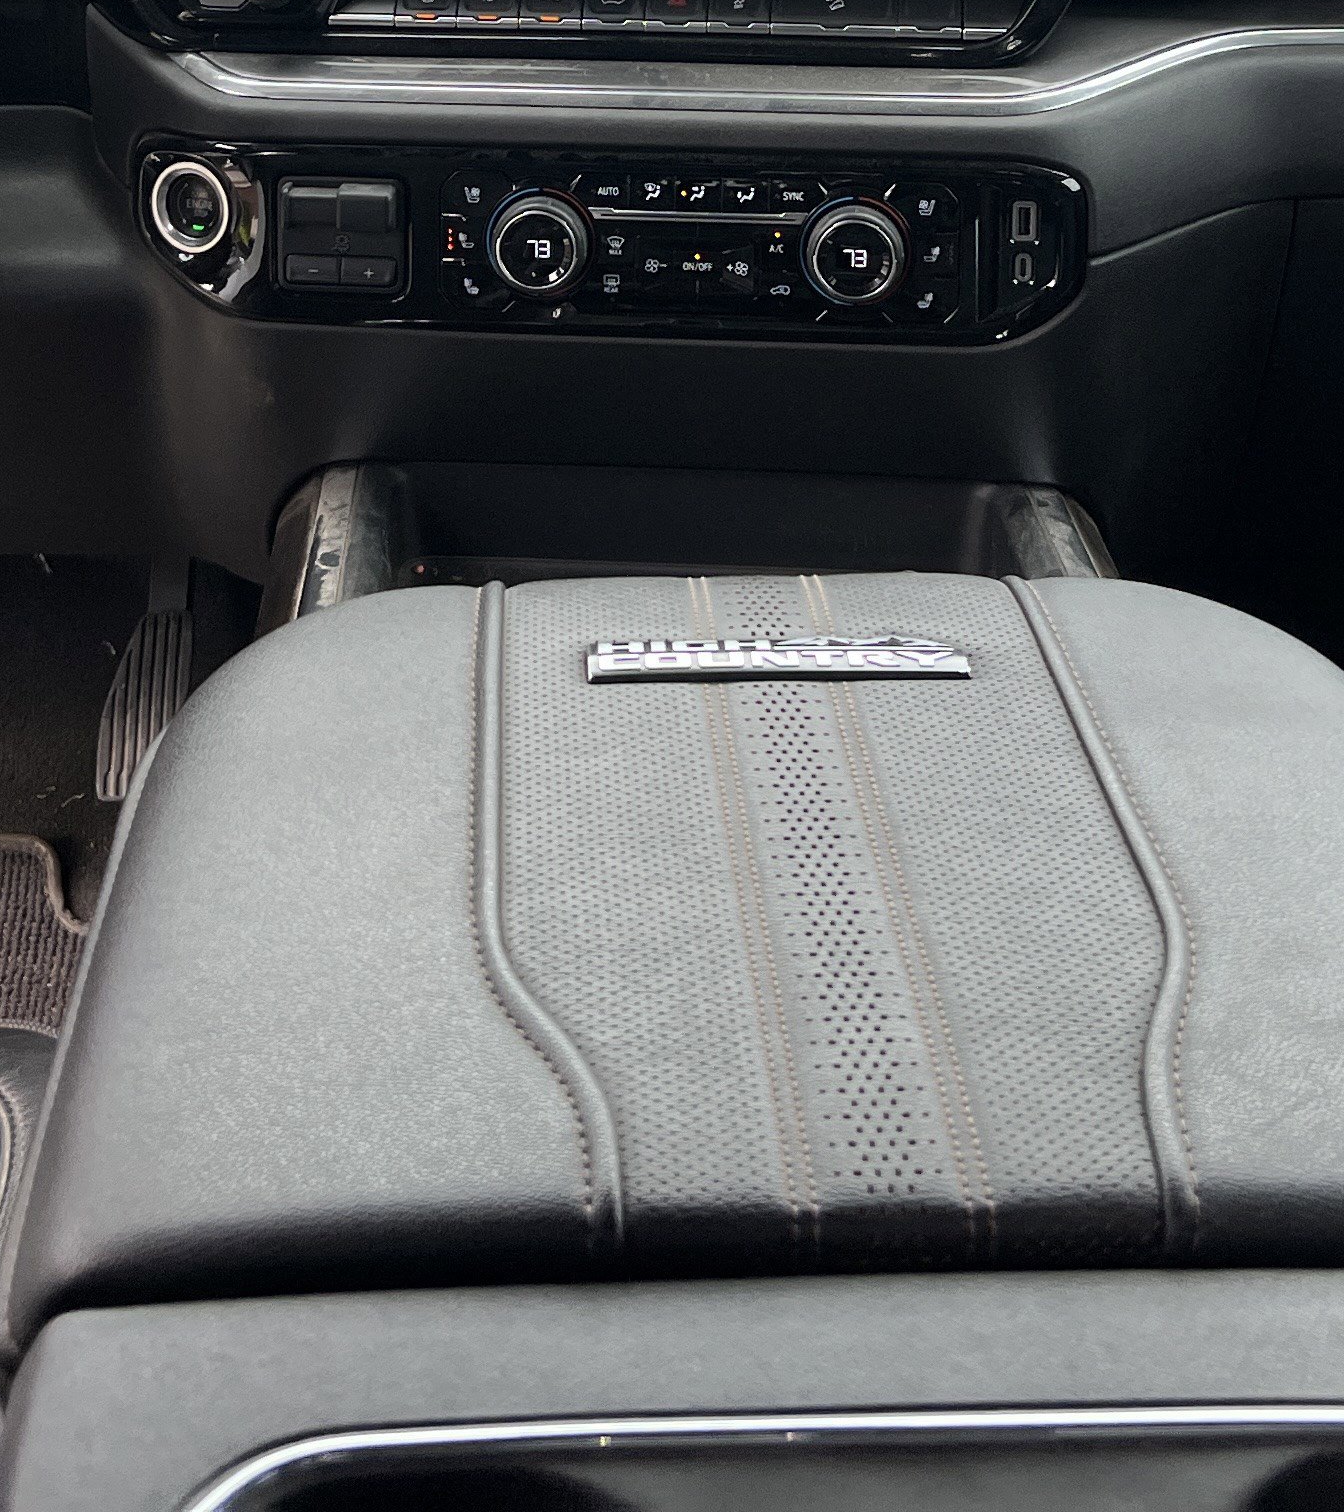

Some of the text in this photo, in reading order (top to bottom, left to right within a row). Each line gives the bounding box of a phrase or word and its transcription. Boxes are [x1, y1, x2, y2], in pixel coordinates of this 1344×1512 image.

[597, 186, 805, 202] AUTO SYNC
[526, 239, 551, 259] 73
[768, 244, 785, 254] A/C
[682, 262, 714, 272] ON/OFF
[842, 249, 867, 268] 73
[596, 650, 954, 671] COUNTRY
